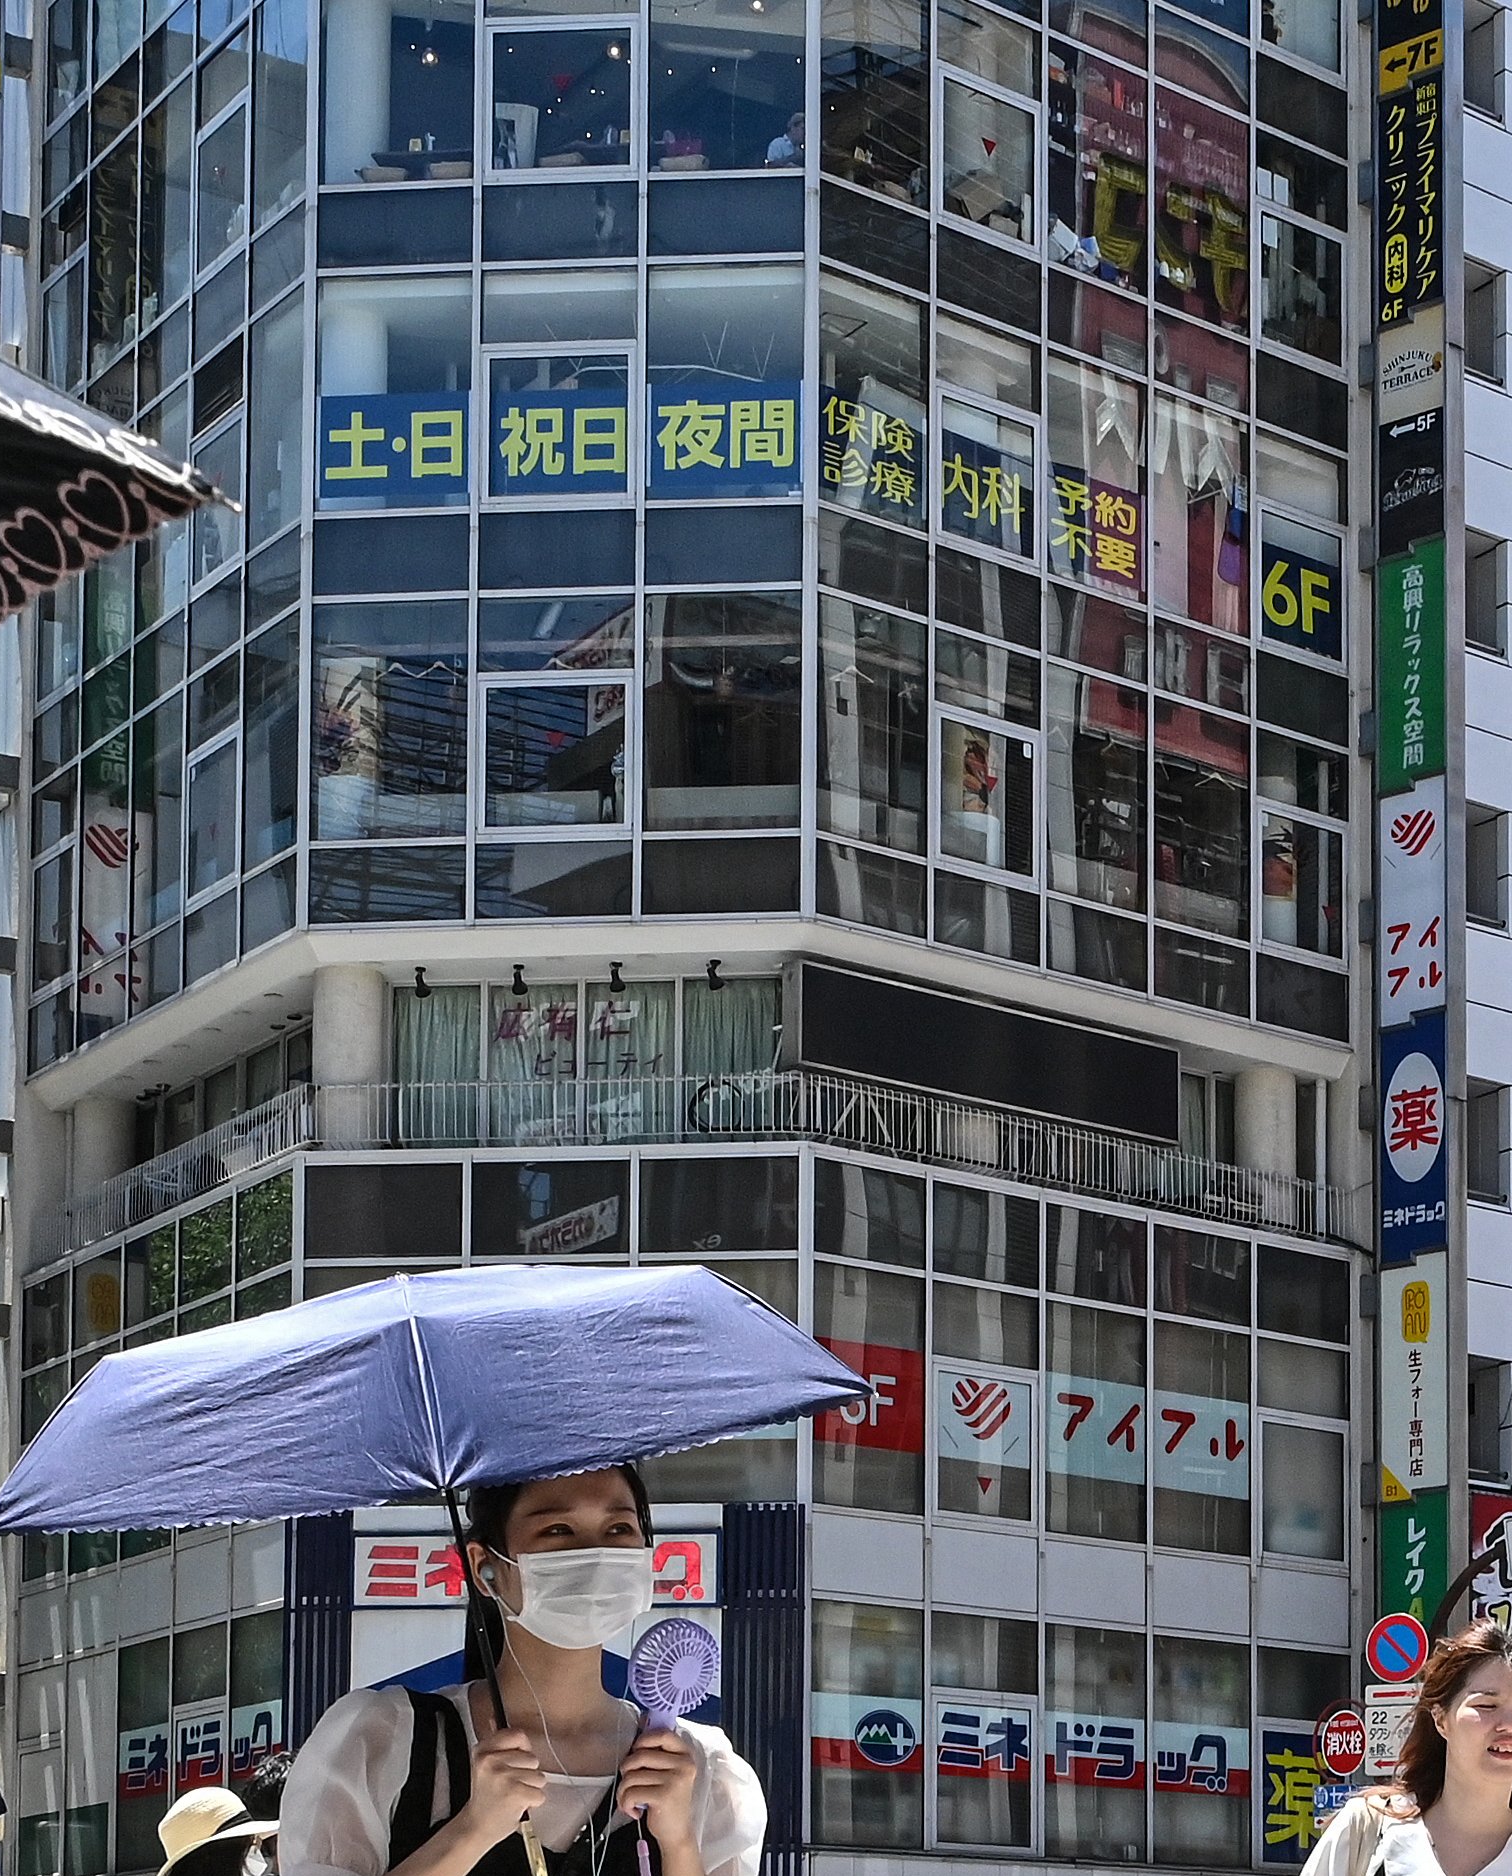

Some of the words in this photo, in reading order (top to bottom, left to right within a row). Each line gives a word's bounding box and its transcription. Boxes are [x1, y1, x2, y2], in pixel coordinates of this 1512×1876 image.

[1406, 37, 1439, 71] 7F
[1385, 105, 1406, 233] クリニック
[1414, 114, 1438, 299] プライマリケア
[1387, 240, 1405, 285] 内科
[1381, 299, 1404, 322] 6F
[1381, 366, 1434, 393] TERRACE
[1382, 350, 1433, 377] SHINJUKU
[498, 404, 628, 476] 祝日
[660, 398, 795, 476] 夜間
[822, 394, 916, 458] 保険
[1416, 412, 1437, 432] 5F
[822, 441, 916, 507] 診療
[941, 452, 1027, 535] 内科
[1054, 474, 1137, 536] 予約
[1051, 518, 1137, 580] 不要
[1261, 559, 1331, 636] 6F
[1402, 563, 1425, 770] 高興リラックス空間
[1387, 914, 1442, 956] アイ
[1387, 960, 1443, 998] フル
[1389, 1083, 1441, 1155] 薬
[1057, 1391, 1246, 1463] アイフル
[1407, 1349, 1425, 1478] 生フォー専門店
[1384, 1485, 1399, 1497] B1
[1326, 1729, 1363, 1757] 消火栓
[1371, 1710, 1388, 1725] 22
